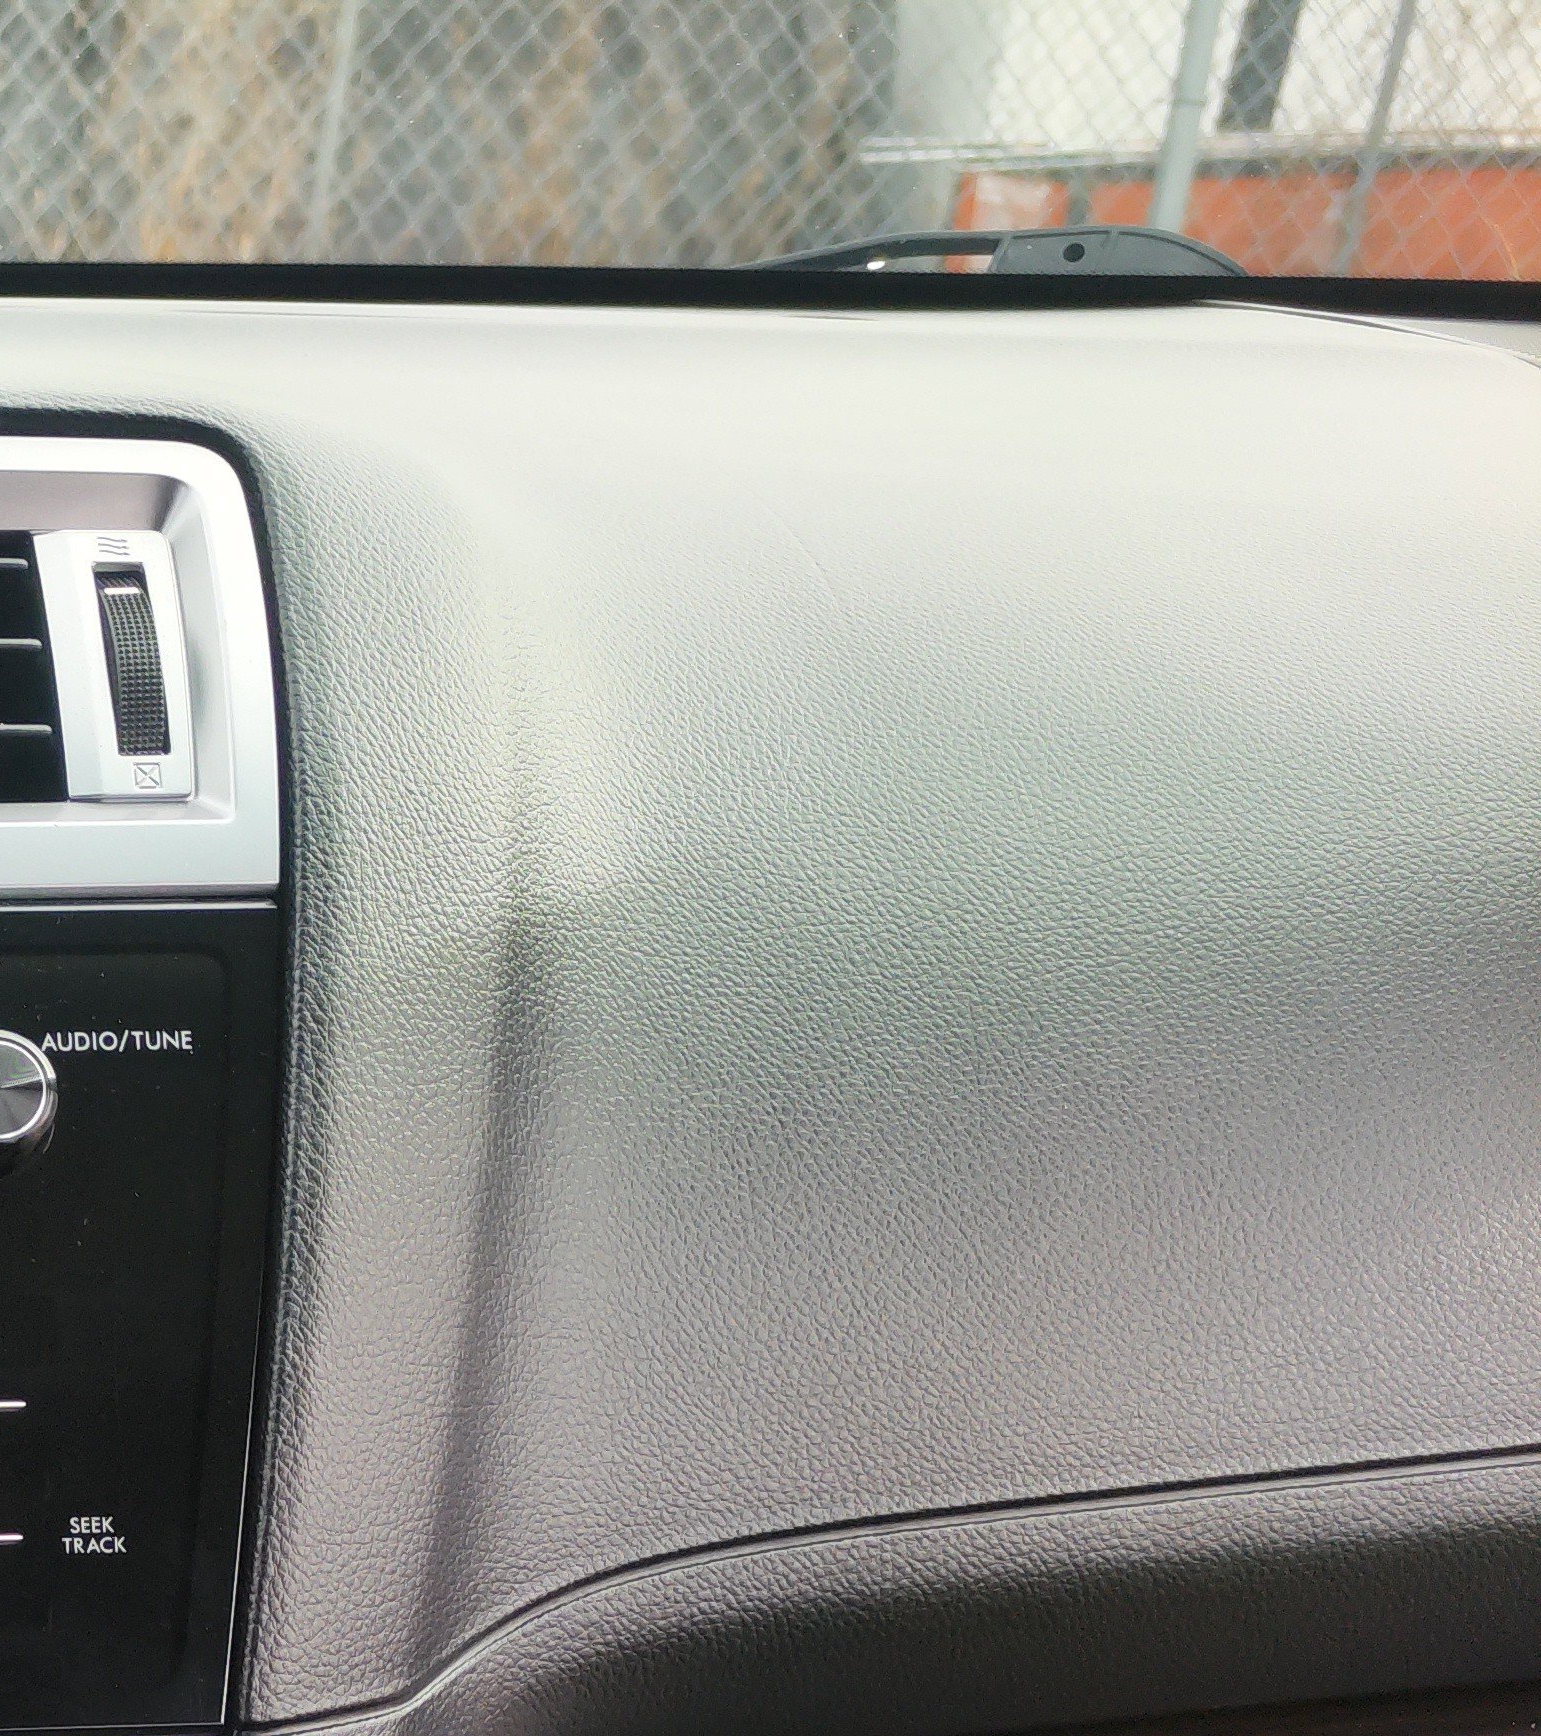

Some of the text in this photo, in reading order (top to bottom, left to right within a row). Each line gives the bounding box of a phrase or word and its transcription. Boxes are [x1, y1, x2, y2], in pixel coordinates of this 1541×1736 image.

[41, 1029, 193, 1053] AUDIO/TUNE
[69, 1516, 114, 1534] SEEK
[61, 1536, 127, 1554] TRACK
